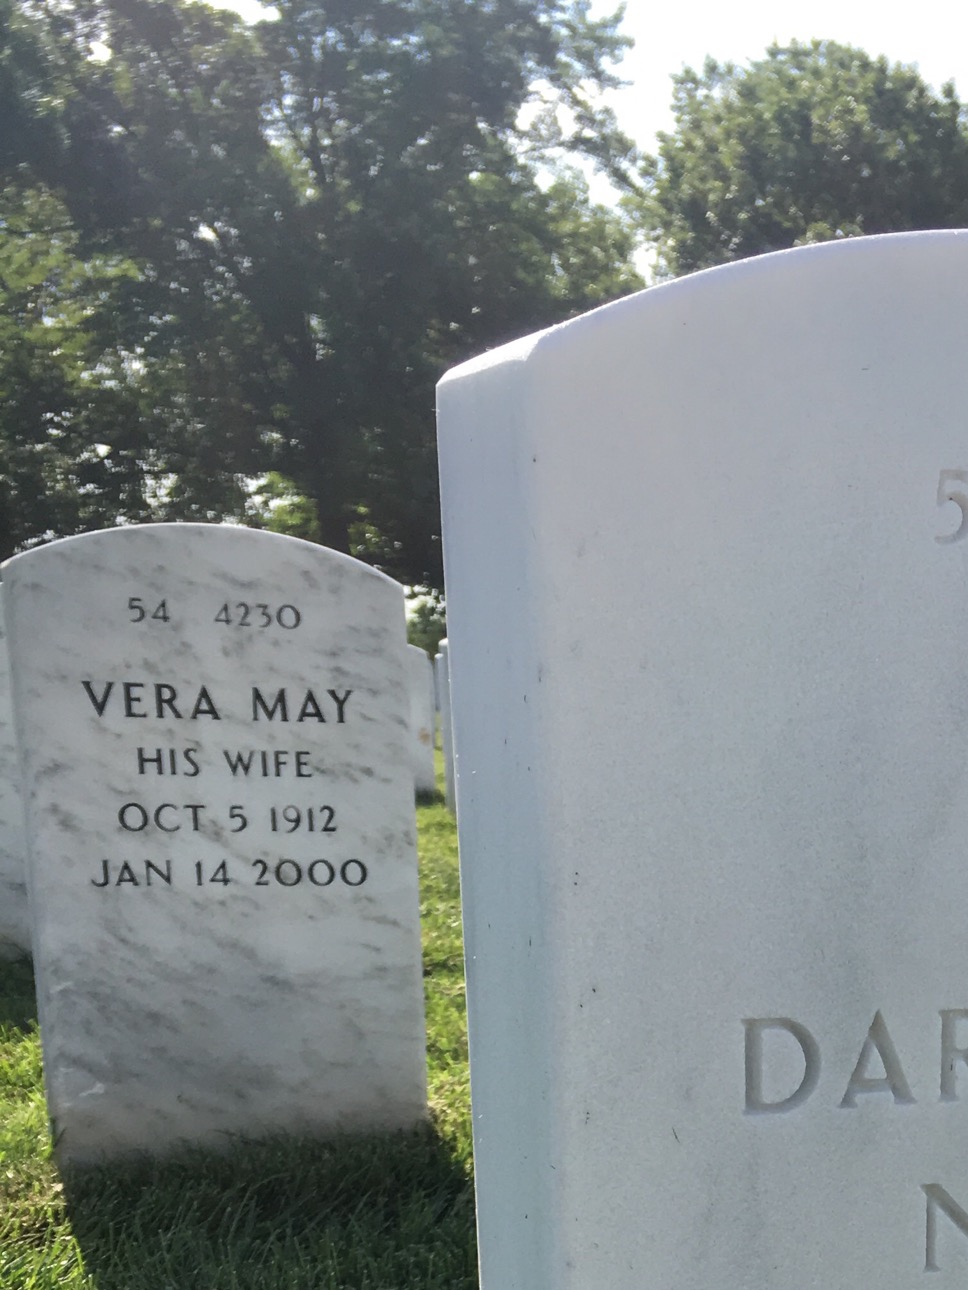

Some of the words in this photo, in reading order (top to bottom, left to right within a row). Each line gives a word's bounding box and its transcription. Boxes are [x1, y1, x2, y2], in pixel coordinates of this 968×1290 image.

[127, 597, 170, 623] 54
[214, 601, 302, 629] 4230
[82, 681, 221, 721] VERA
[252, 687, 353, 724] MAY
[136, 747, 200, 777] HIS
[224, 750, 313, 778] WIFE
[118, 803, 205, 833] OCT
[228, 806, 247, 833] 5
[269, 805, 338, 833] 1912
[90, 859, 172, 888] JAN
[195, 860, 232, 887] 14
[252, 858, 368, 888] 2000
